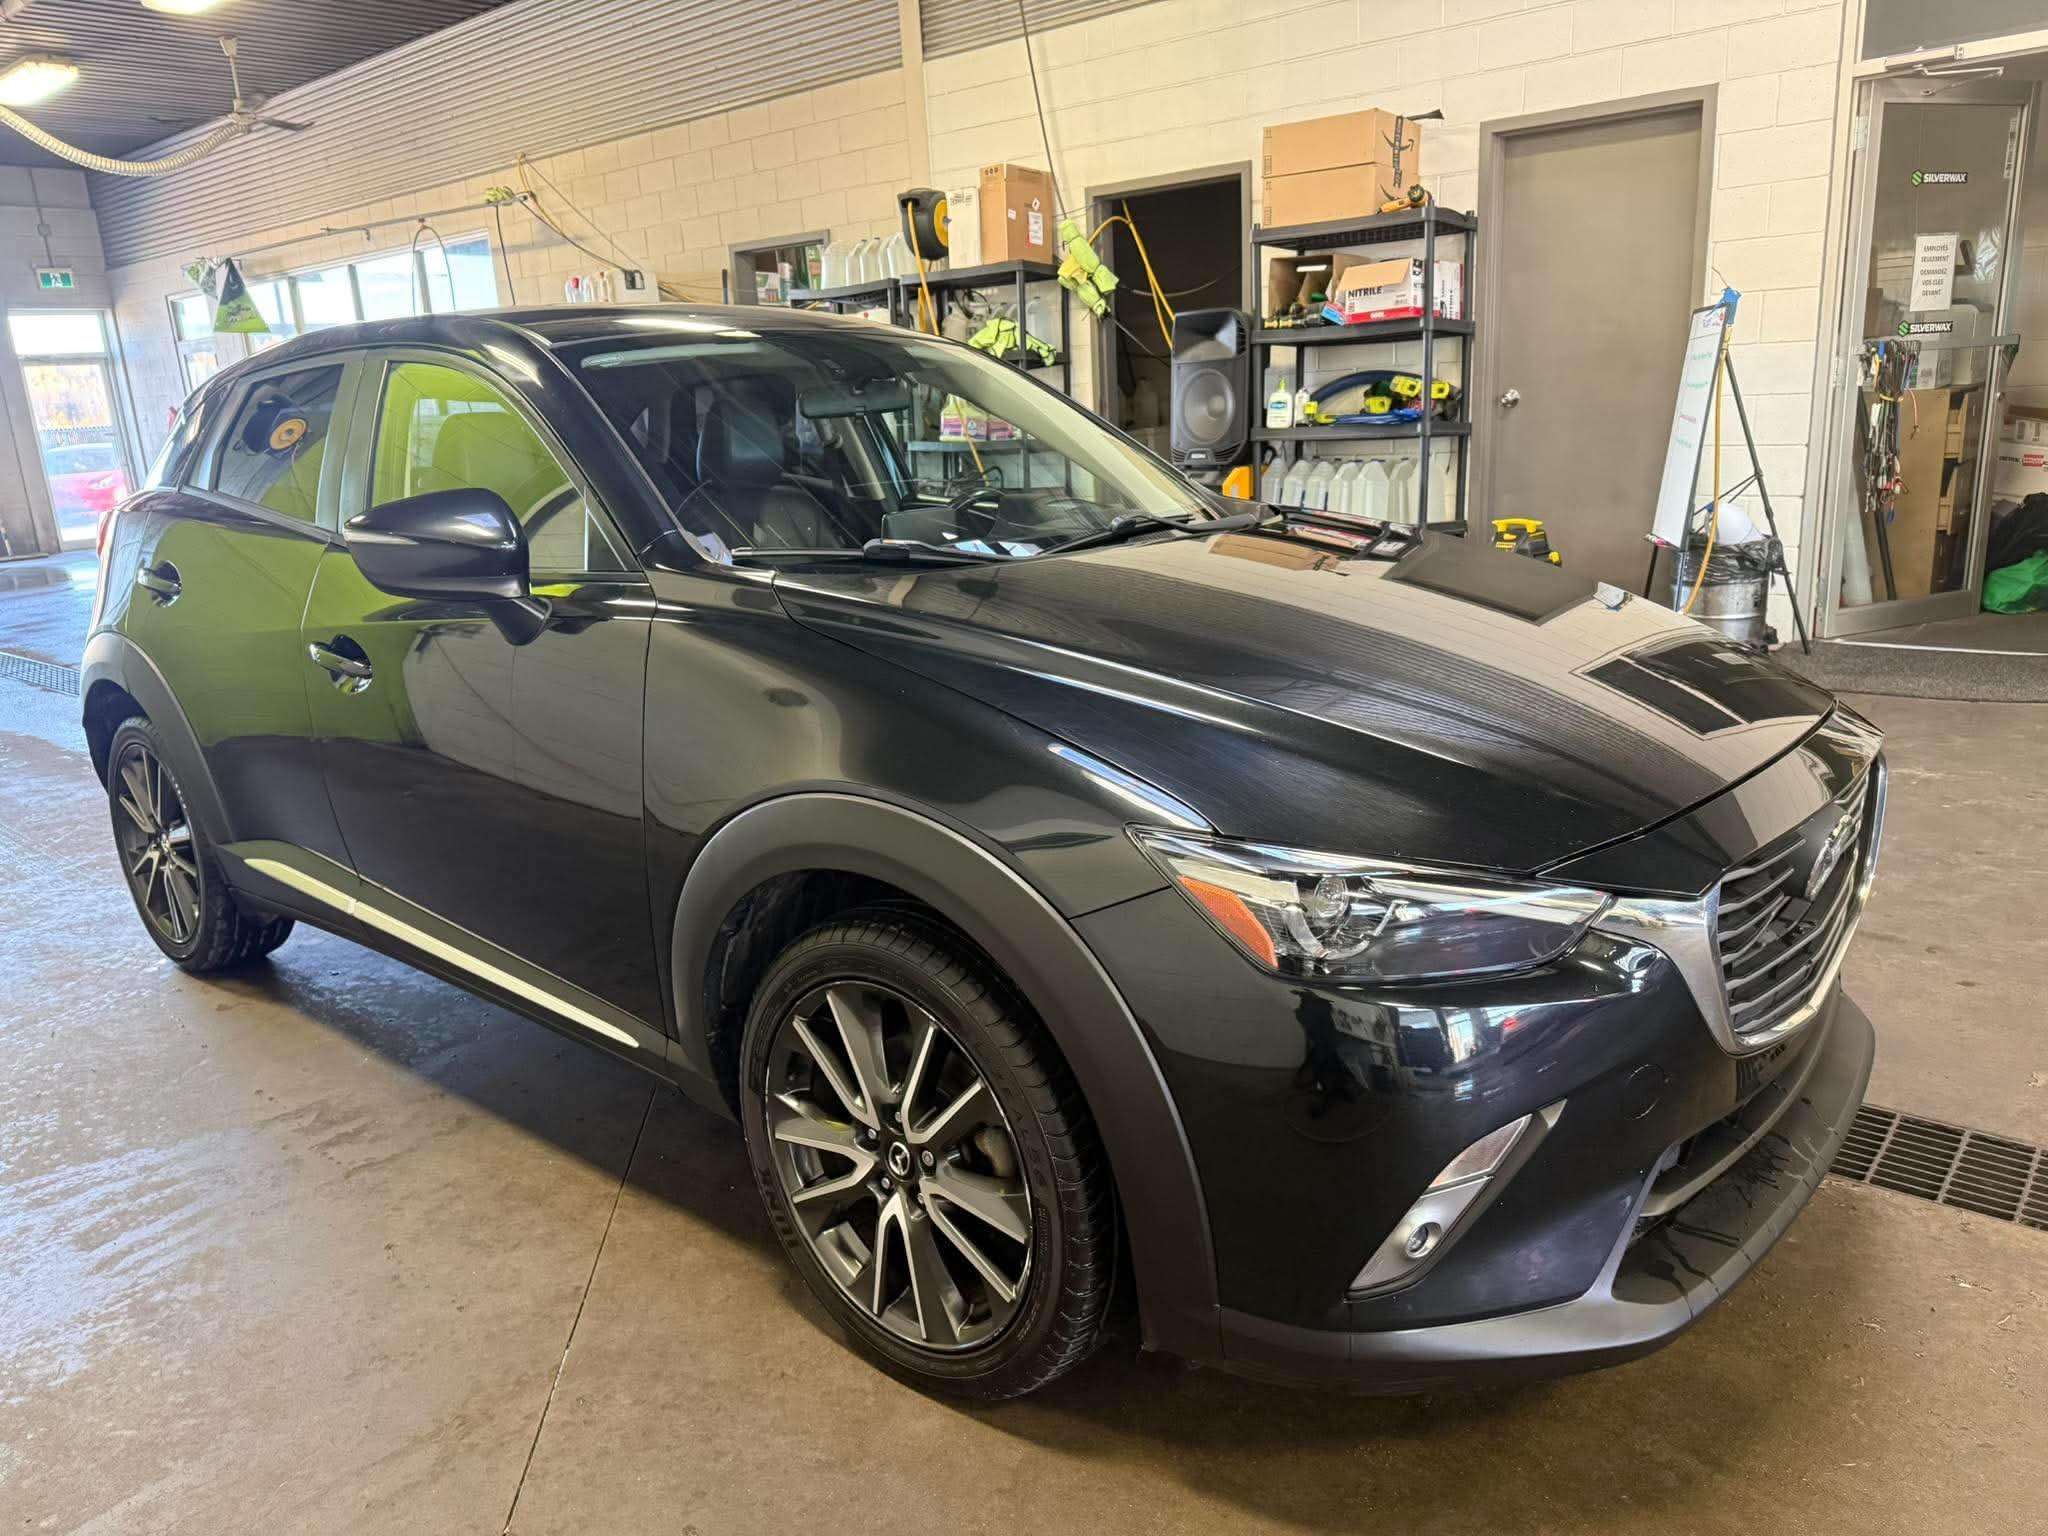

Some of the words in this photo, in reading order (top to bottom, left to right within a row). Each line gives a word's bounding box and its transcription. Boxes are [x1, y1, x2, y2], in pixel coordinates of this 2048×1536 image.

[1923, 173, 1966, 182] SILVERWAX
[1348, 286, 1382, 298] NITRILE
[1910, 322, 1951, 333] SILVERWAX
